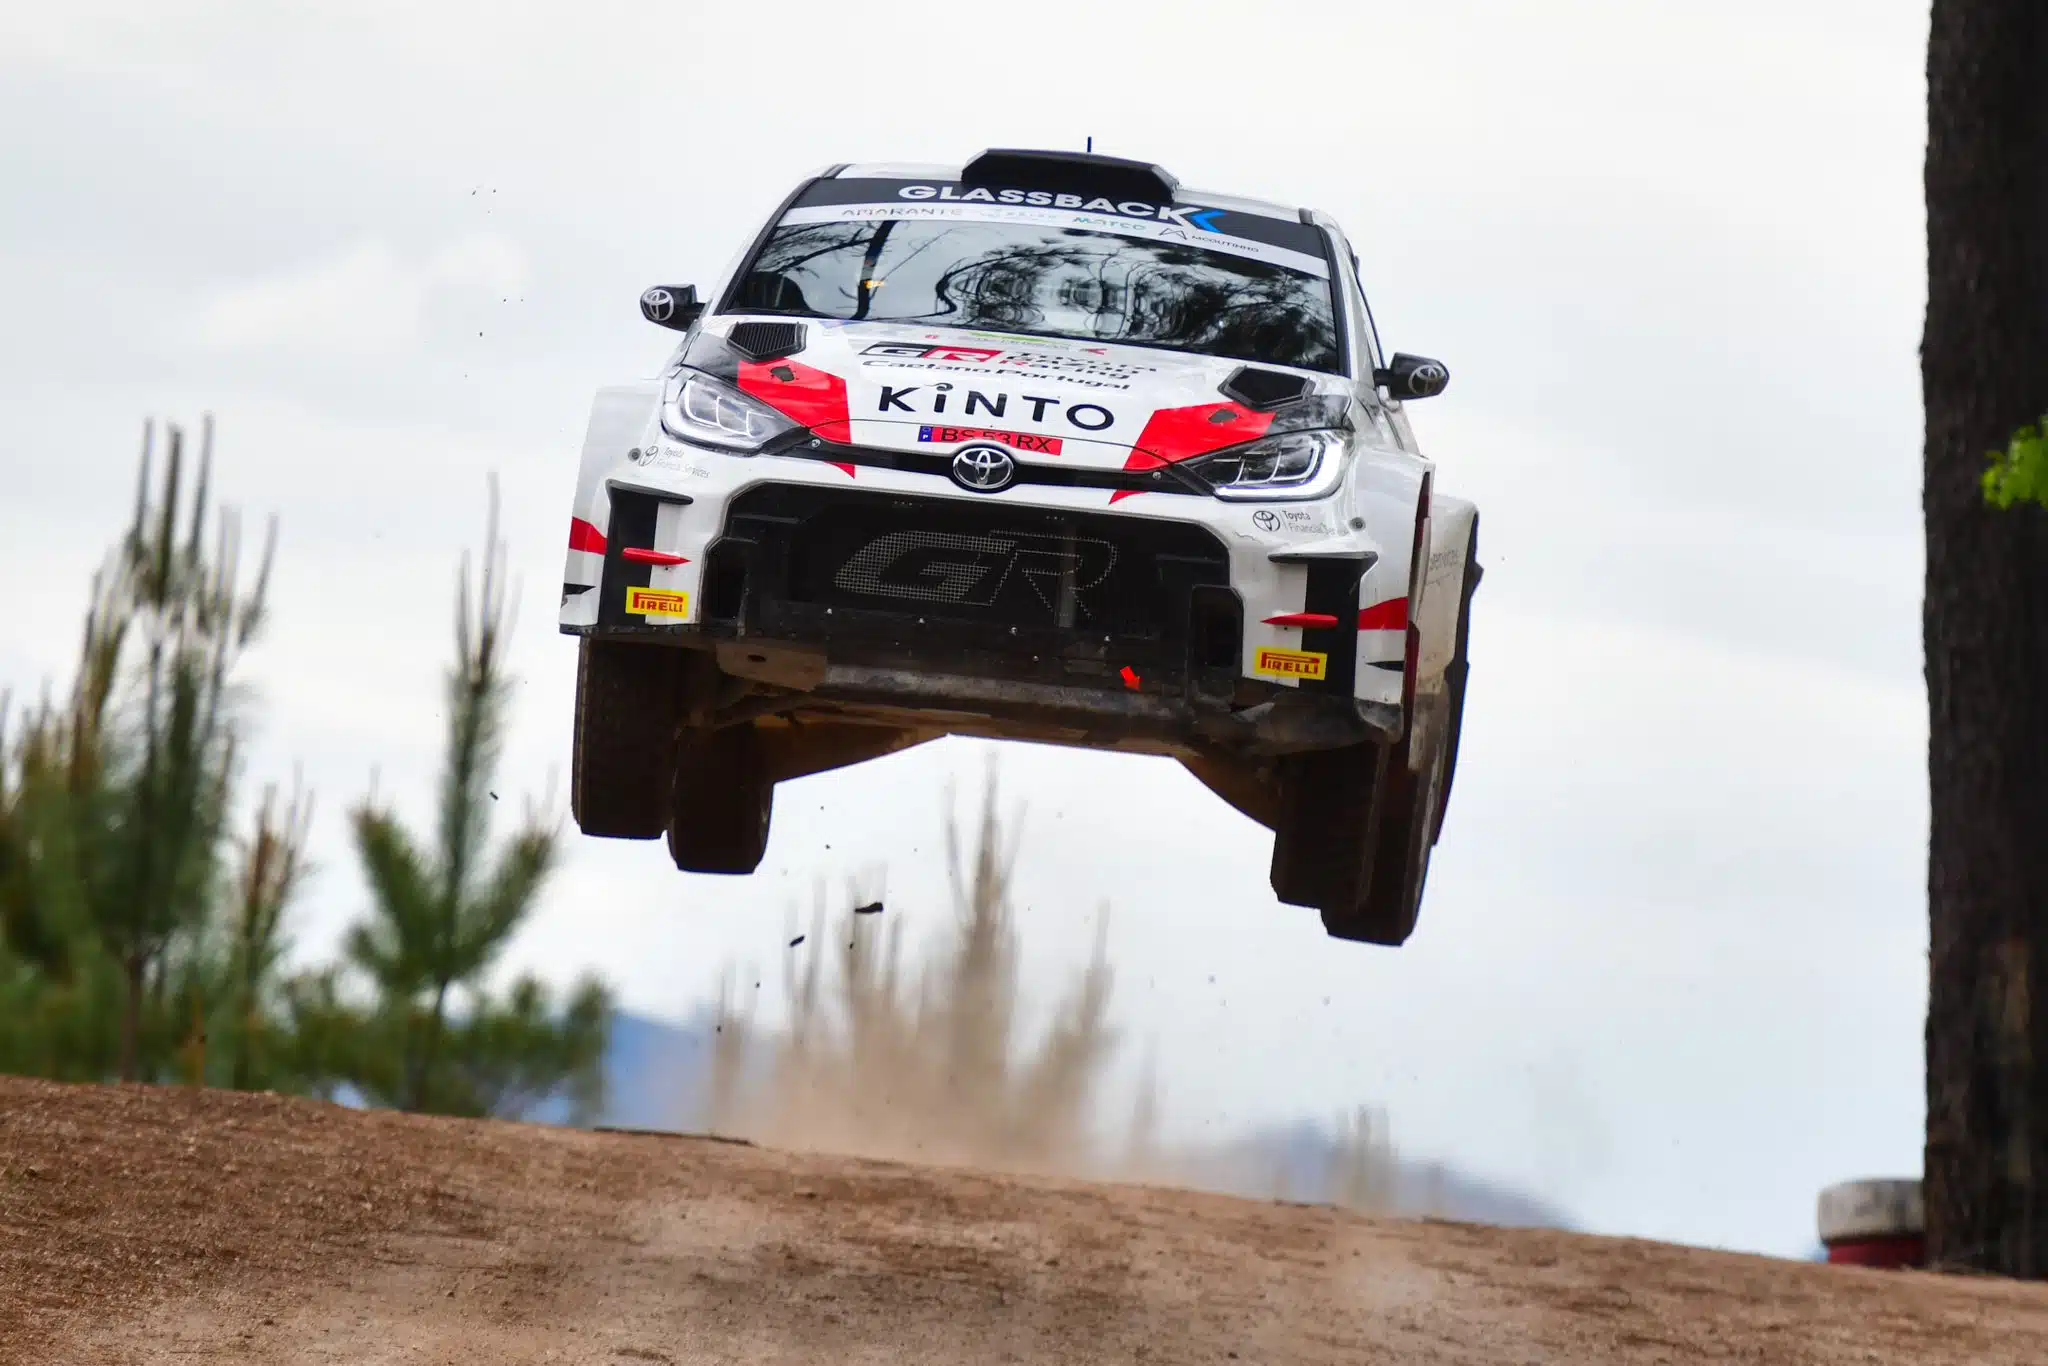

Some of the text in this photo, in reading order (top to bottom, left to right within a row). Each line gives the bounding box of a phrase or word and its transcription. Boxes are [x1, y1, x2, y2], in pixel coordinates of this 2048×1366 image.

[898, 185, 1203, 230] GLASSBACK
[858, 341, 1004, 363] GR
[862, 360, 1131, 390] Caetano Portugal
[1015, 434, 1053, 453] RX
[1282, 509, 1312, 522] Toyota
[832, 529, 1118, 621] GR
[632, 591, 684, 613] PIRELLI
[1260, 651, 1321, 676] PIRELLI
